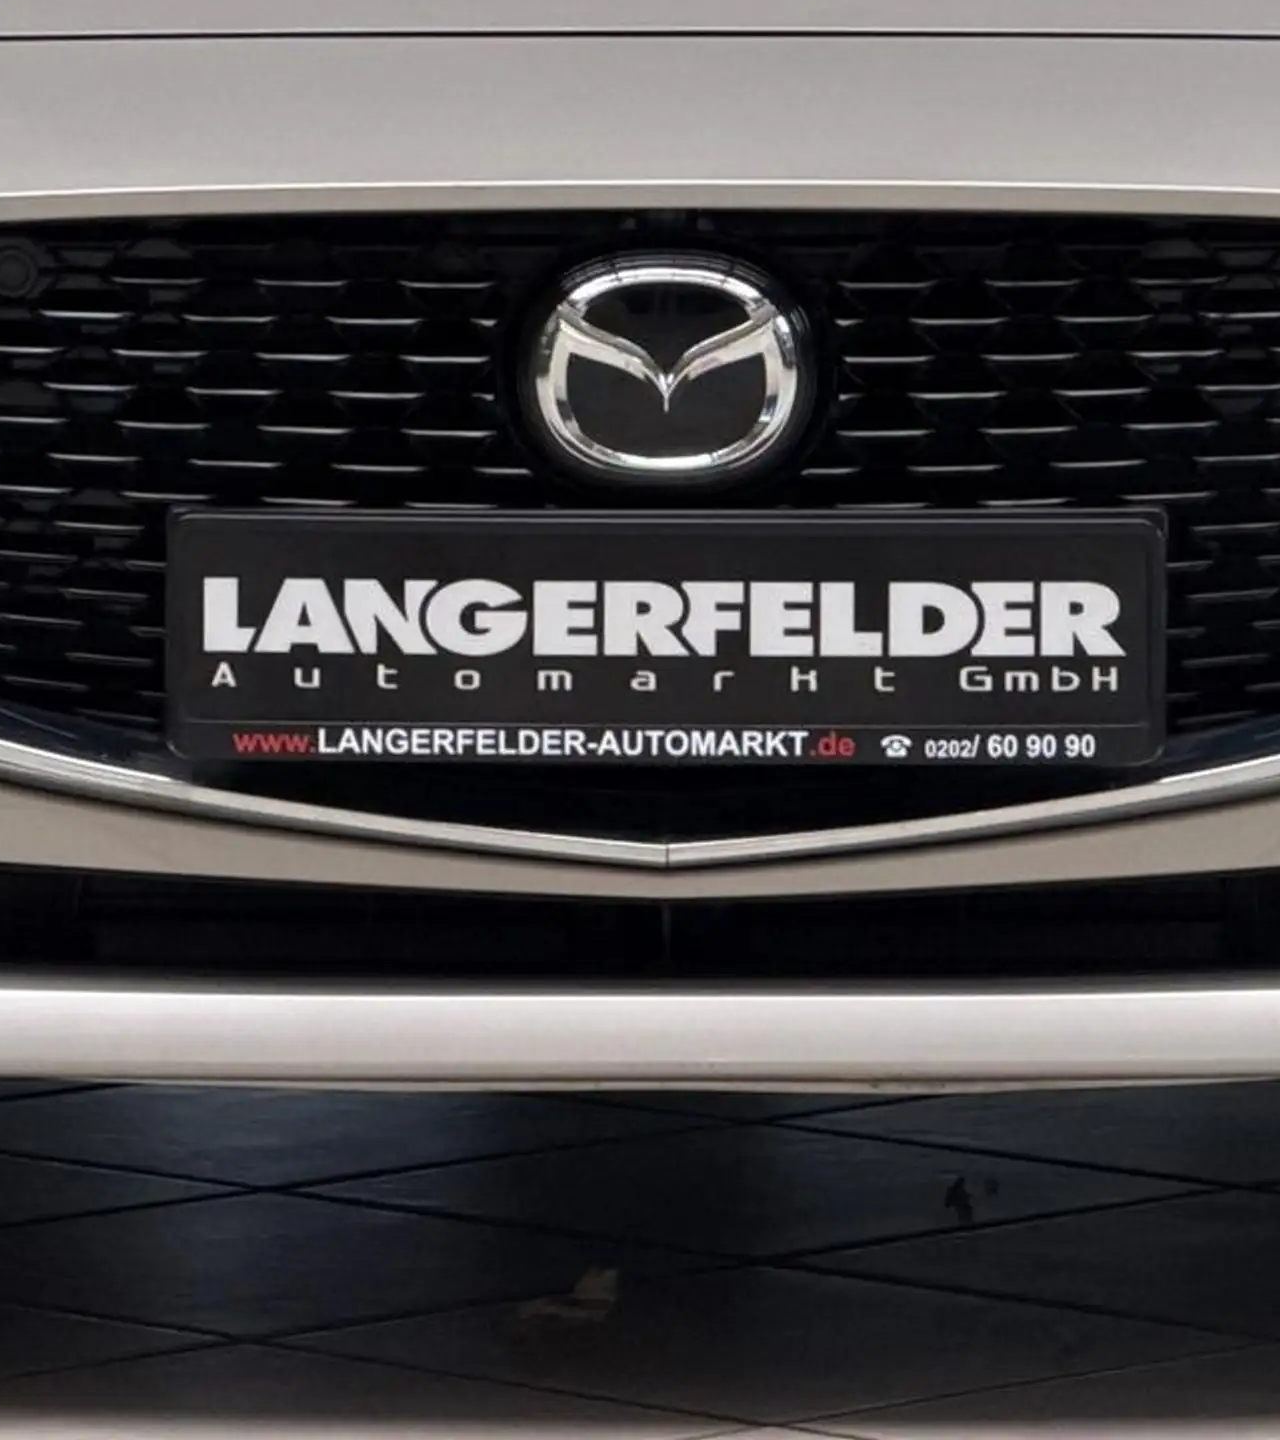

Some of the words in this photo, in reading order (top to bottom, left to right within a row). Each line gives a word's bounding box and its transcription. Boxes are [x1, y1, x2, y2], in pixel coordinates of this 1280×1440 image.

[203, 576, 1126, 657] LANGERFELDER
[959, 665, 1118, 692] GmbH
[233, 727, 855, 758] www.LANGERFELDER-AUTOMARKT.de
[924, 733, 981, 759] 0202/
[986, 733, 1019, 758] 60
[1025, 733, 1058, 758] 90
[1063, 733, 1096, 758] 90
